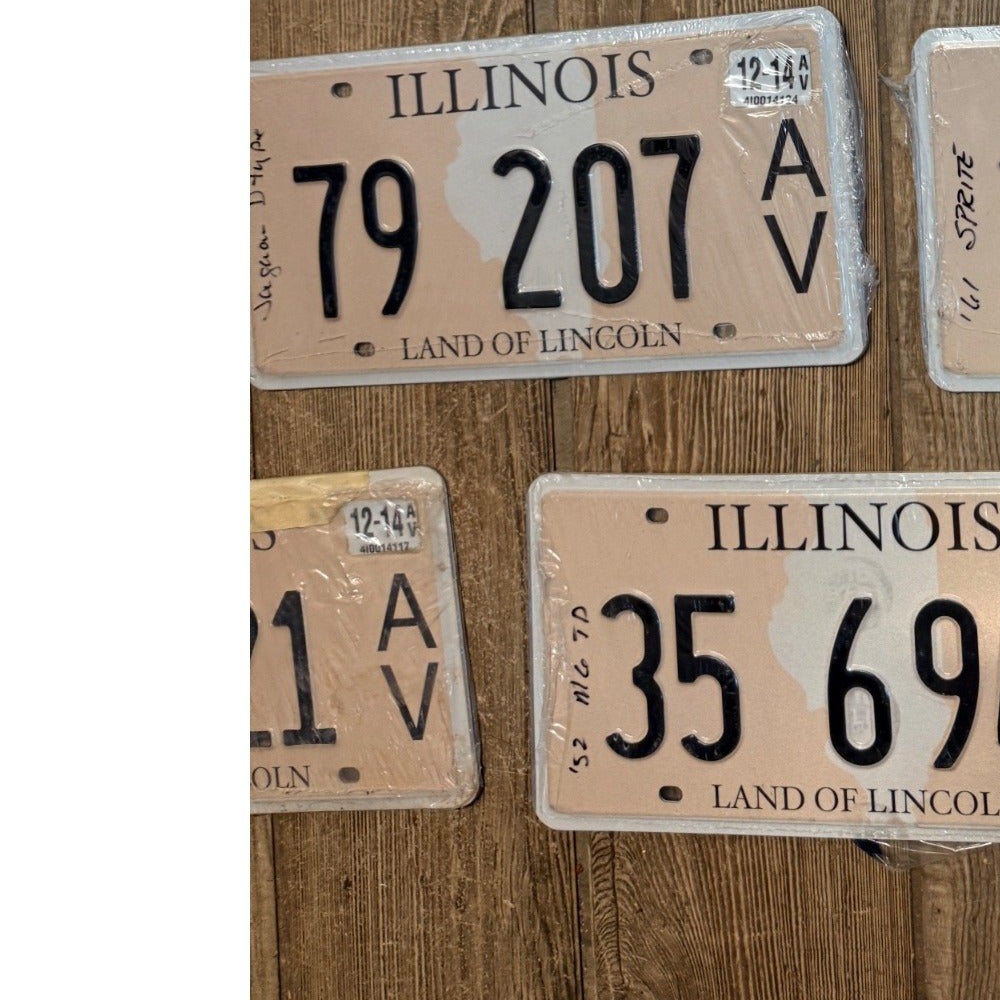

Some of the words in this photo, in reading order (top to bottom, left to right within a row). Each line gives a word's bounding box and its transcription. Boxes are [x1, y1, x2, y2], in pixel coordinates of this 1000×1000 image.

[389, 50, 656, 120] ILLINOIS
[736, 55, 795, 91] 12-14
[952, 141, 979, 251] SPRITE
[292, 158, 418, 320] 79
[492, 133, 700, 310] 207
[400, 333, 482, 362] LAND
[492, 331, 530, 356] OF
[539, 322, 683, 354] LINCOLN
[350, 504, 404, 538] 12-14
[600, 594, 743, 763] 35
[250, 765, 311, 789] OLN
[711, 783, 806, 811] LAND
[814, 785, 859, 813] OF
